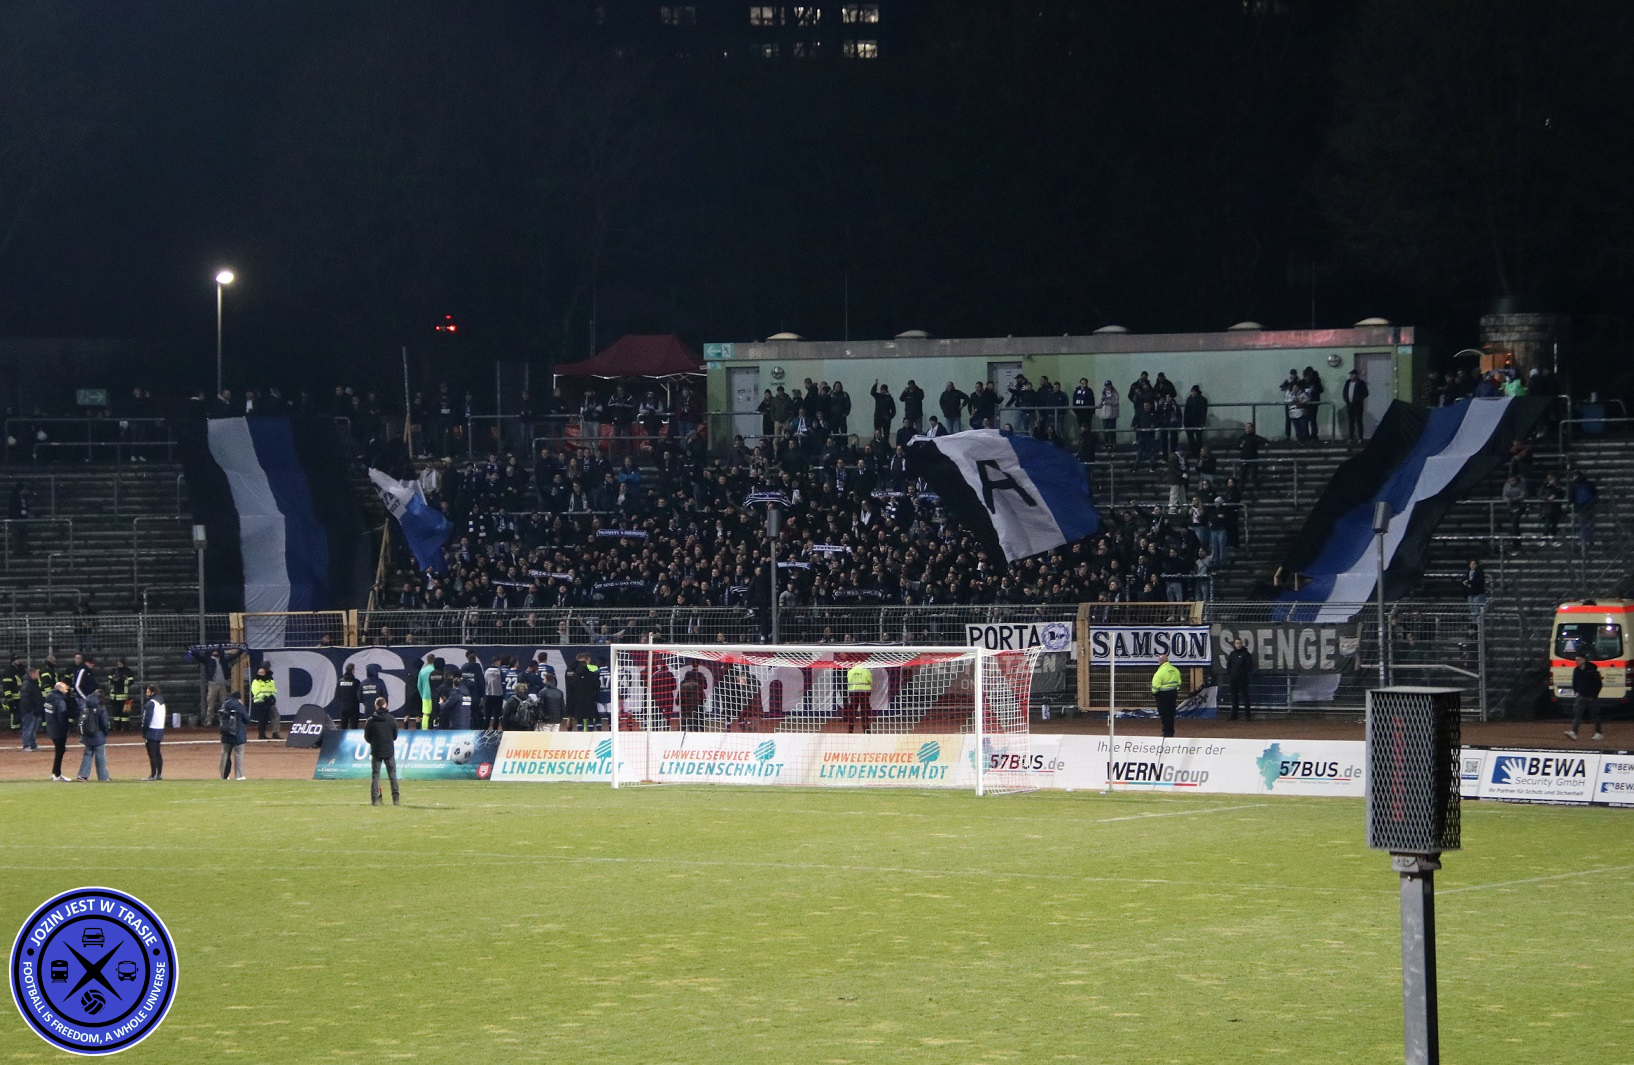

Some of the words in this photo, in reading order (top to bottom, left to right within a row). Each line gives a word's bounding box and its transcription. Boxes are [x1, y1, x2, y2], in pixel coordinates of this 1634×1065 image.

[968, 624, 1041, 650] PORTA
[1092, 631, 1208, 659] SAMSON
[1218, 628, 1336, 670] SPENGE
[505, 677, 518, 690] 22
[599, 675, 611, 689] 17
[290, 720, 323, 735] SCHÜCO
[505, 749, 591, 760] UMWELTSERVICE
[663, 749, 751, 761] UMWELTSERVICE
[1123, 741, 1203, 757] Reisepartner
[1204, 744, 1226, 755] der
[823, 752, 913, 763] UMWELTSERVICE
[990, 754, 1065, 770] 57BUS.de
[659, 761, 784, 777] LINDENSCHMIDT
[820, 764, 949, 780] LINDENSCHMIDT
[1106, 761, 1209, 786] WERNGroup
[1279, 760, 1363, 779] 57BUS.de
[1527, 757, 1586, 777] BEWA
[1515, 777, 1553, 787] Security
[1555, 778, 1585, 787] GmbH
